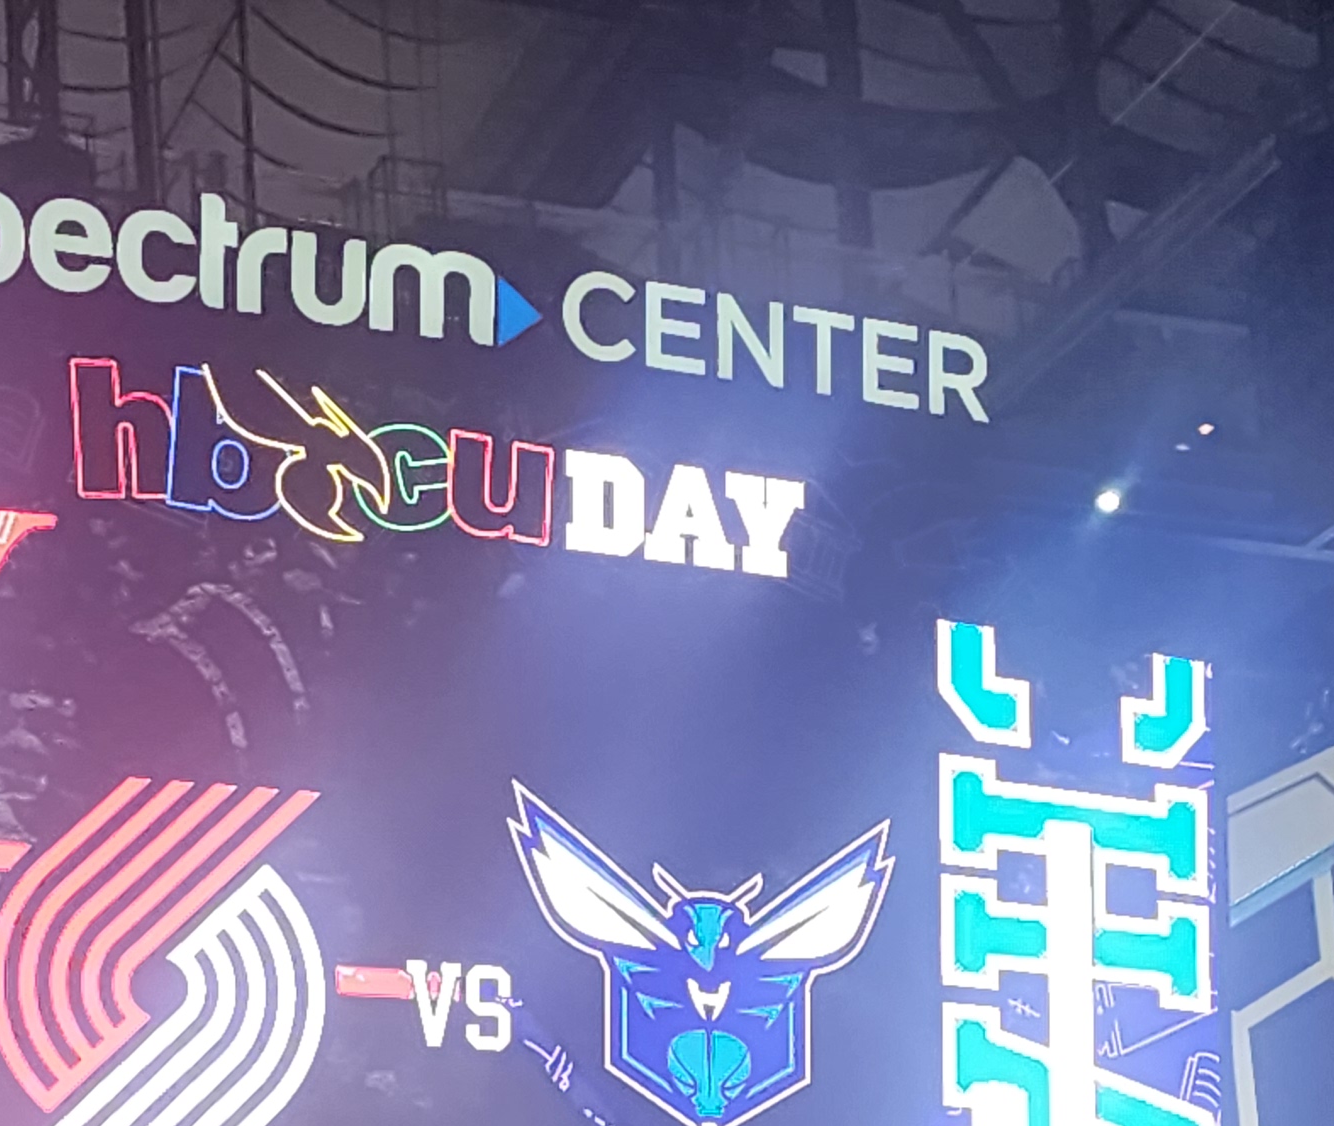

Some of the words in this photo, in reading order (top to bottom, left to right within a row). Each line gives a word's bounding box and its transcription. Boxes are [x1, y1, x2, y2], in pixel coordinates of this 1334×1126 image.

[562, 271, 989, 423] CENTER
[565, 449, 805, 578] DAY
[406, 959, 512, 1052] VS
